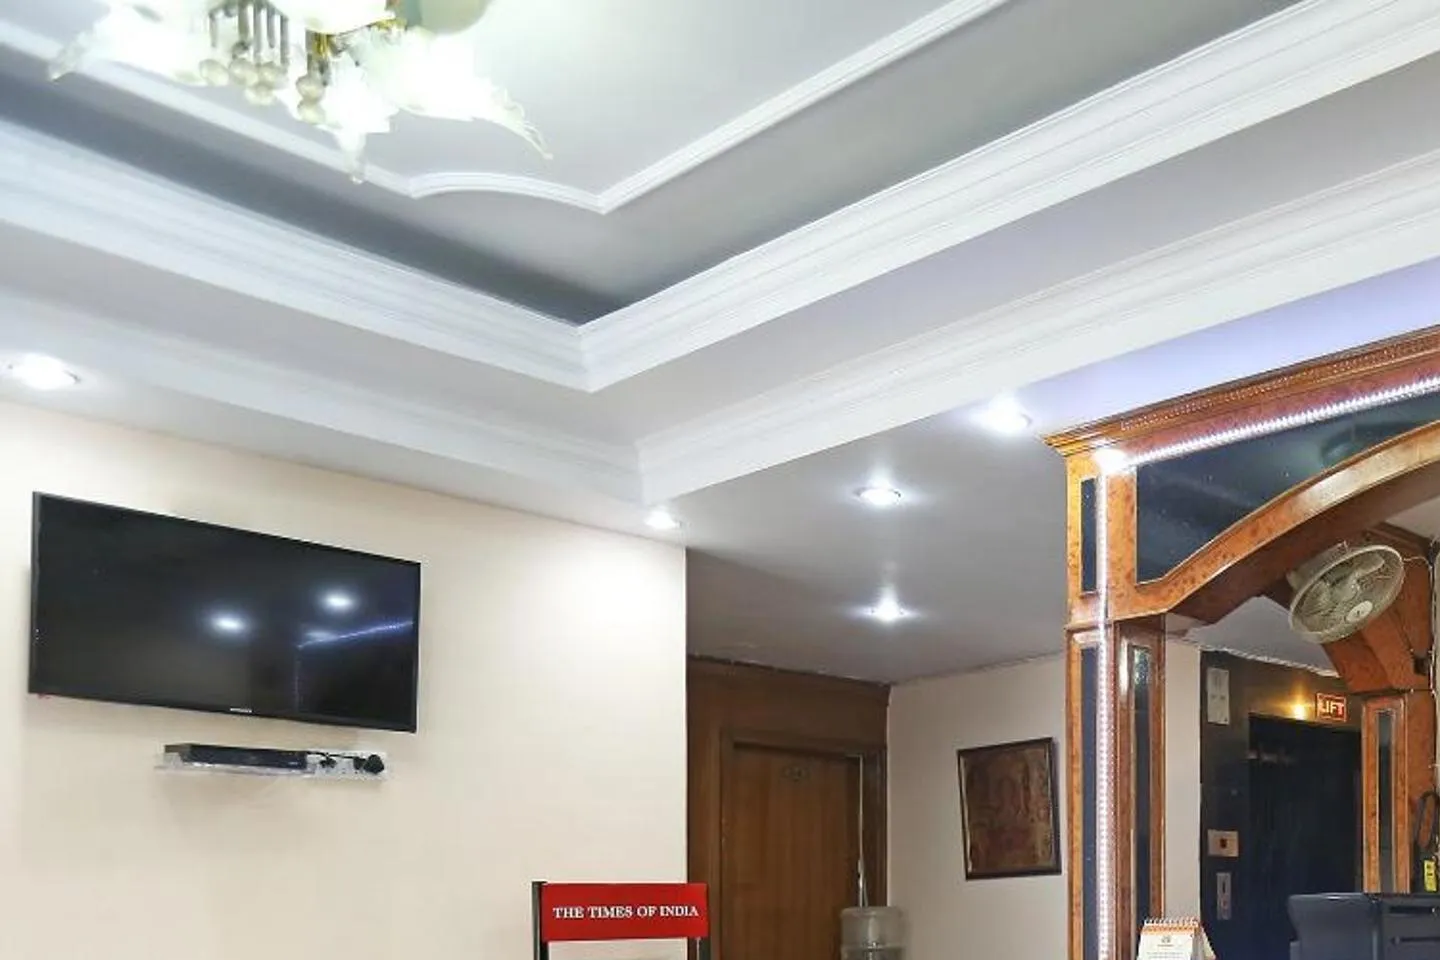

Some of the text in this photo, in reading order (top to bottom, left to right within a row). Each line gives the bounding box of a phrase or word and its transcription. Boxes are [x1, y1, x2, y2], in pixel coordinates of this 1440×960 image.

[1318, 700, 1345, 715] LIFT
[552, 905, 699, 919] THE TIMES OF INDIA
